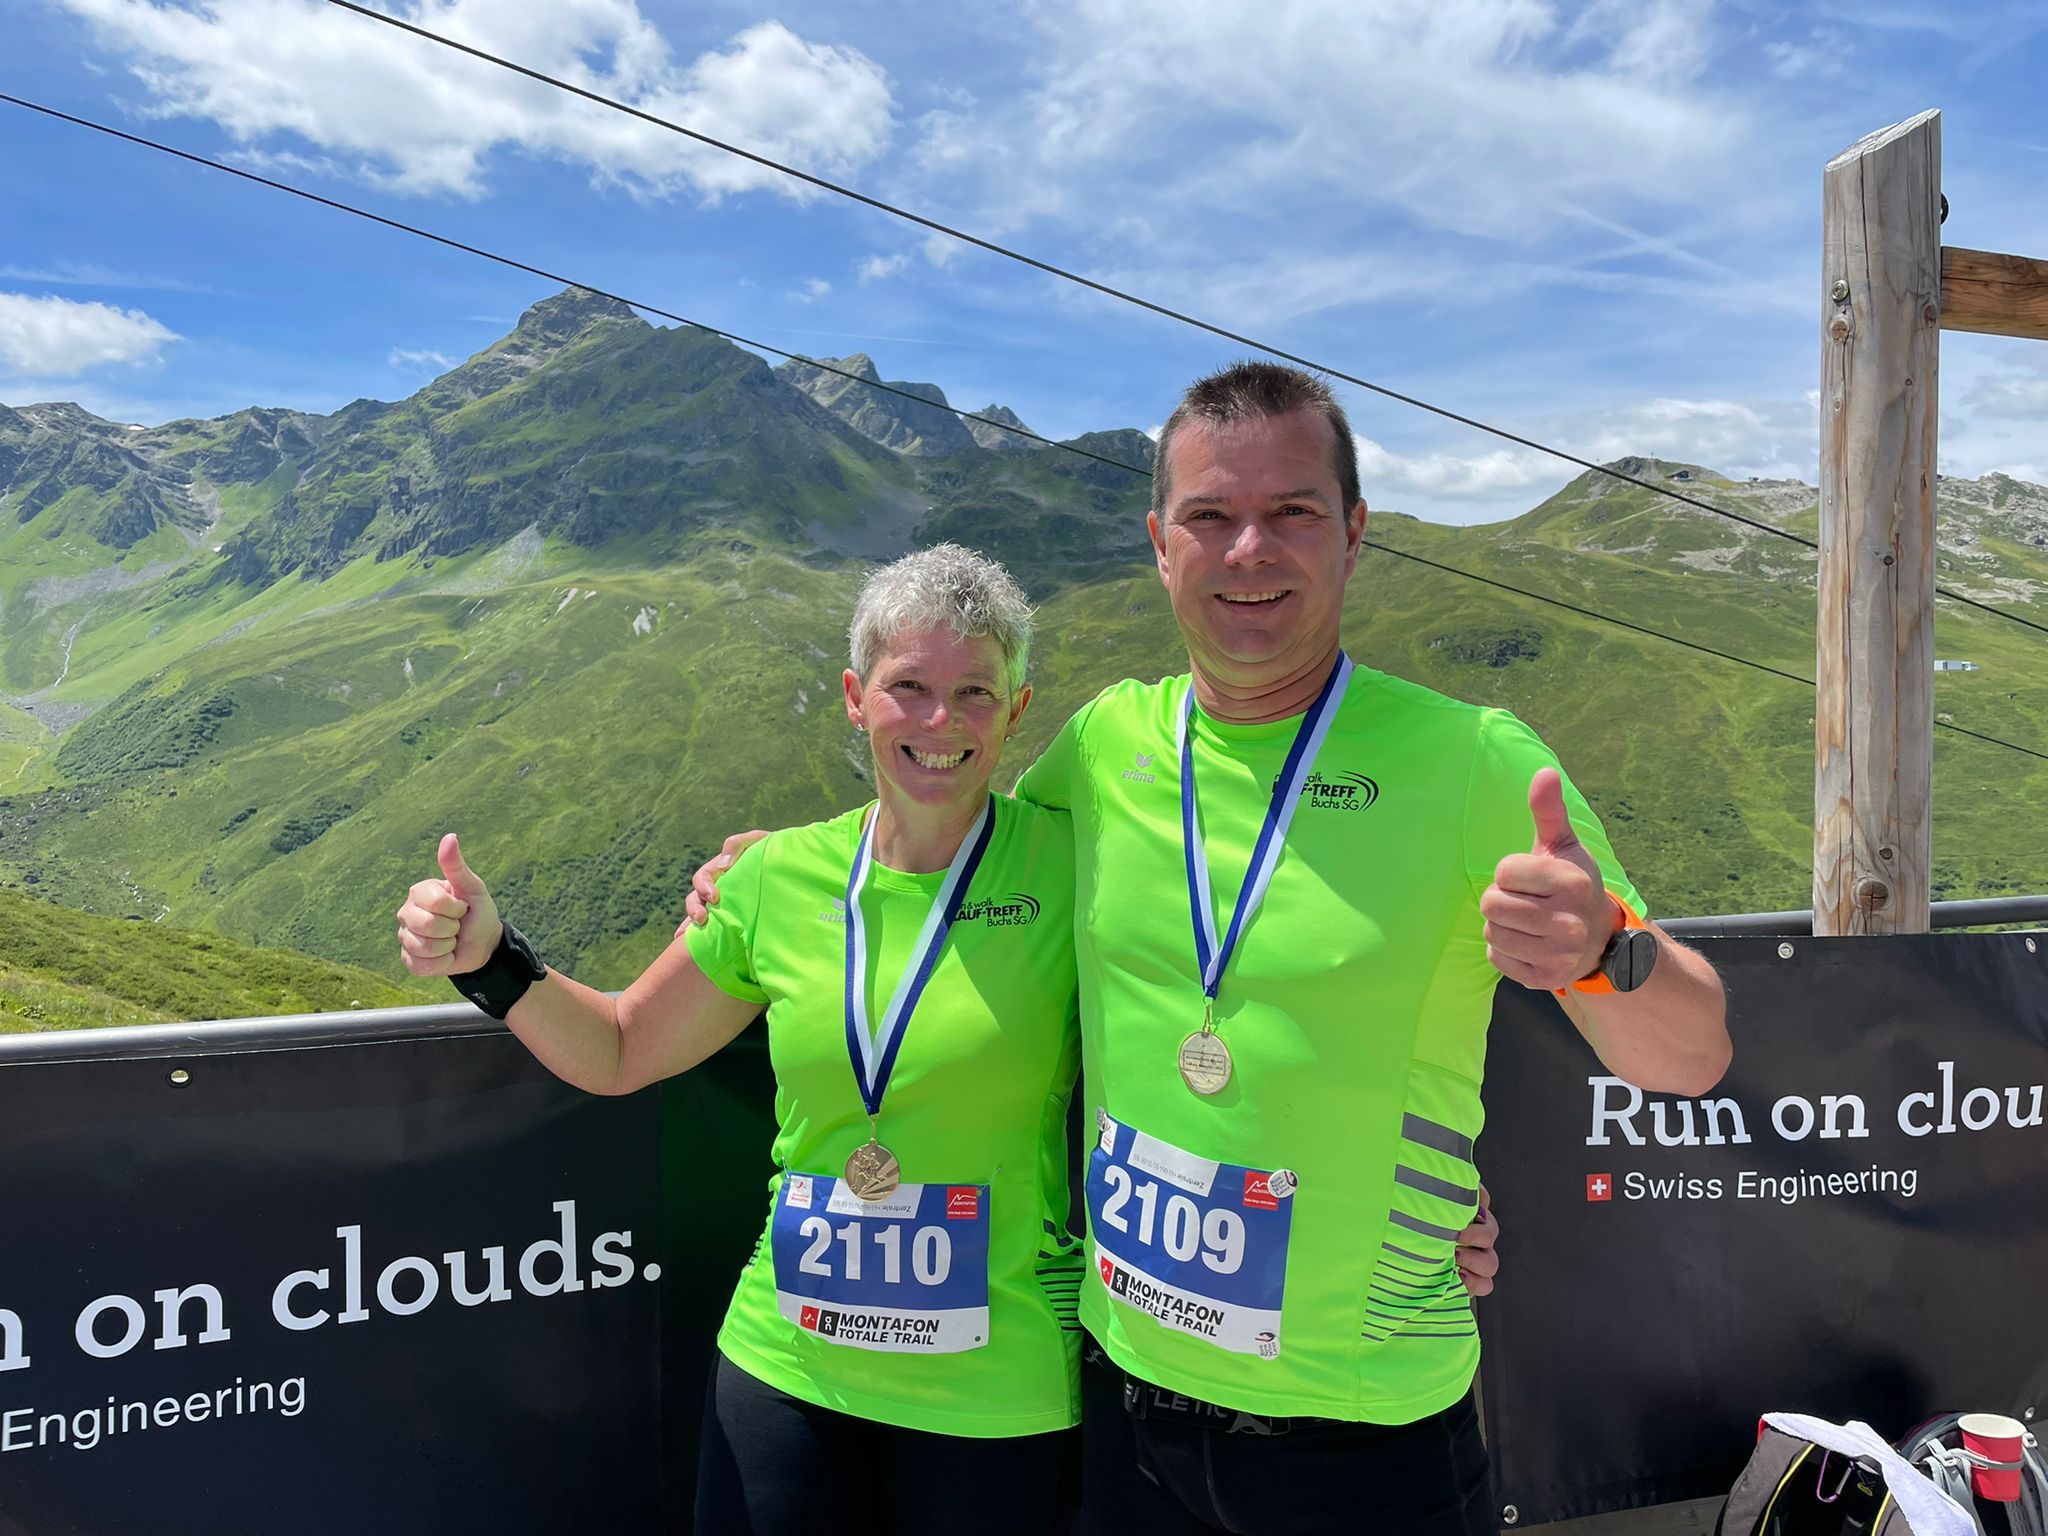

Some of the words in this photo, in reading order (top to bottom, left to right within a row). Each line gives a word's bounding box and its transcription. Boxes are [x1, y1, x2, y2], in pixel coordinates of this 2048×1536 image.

[1311, 796, 1340, 810] Buchs
[1341, 799, 1360, 811] SG
[974, 897, 995, 909] walk
[987, 915, 1012, 928] Buchs
[1013, 915, 1028, 926] SG
[1585, 1074, 1752, 1147] Run
[1771, 1093, 1870, 1142] on
[1897, 1060, 2045, 1136] clou
[1623, 1170, 1723, 1201] Swiss
[1737, 1163, 1919, 1205] Engineering
[1101, 1164, 1246, 1276] 2109
[799, 1216, 952, 1287] 2110
[75, 1282, 231, 1359] on
[272, 1199, 663, 1332] clouds.
[1129, 1275, 1225, 1326] MONTAFON
[838, 1328, 889, 1344] TOTALE
[894, 1332, 935, 1346] TRAIL
[839, 1312, 940, 1334] MONTAFON
[1127, 1290, 1169, 1321] TOTALE
[1174, 1314, 1217, 1337] TRAIL
[1, 1376, 306, 1453] Engineering
